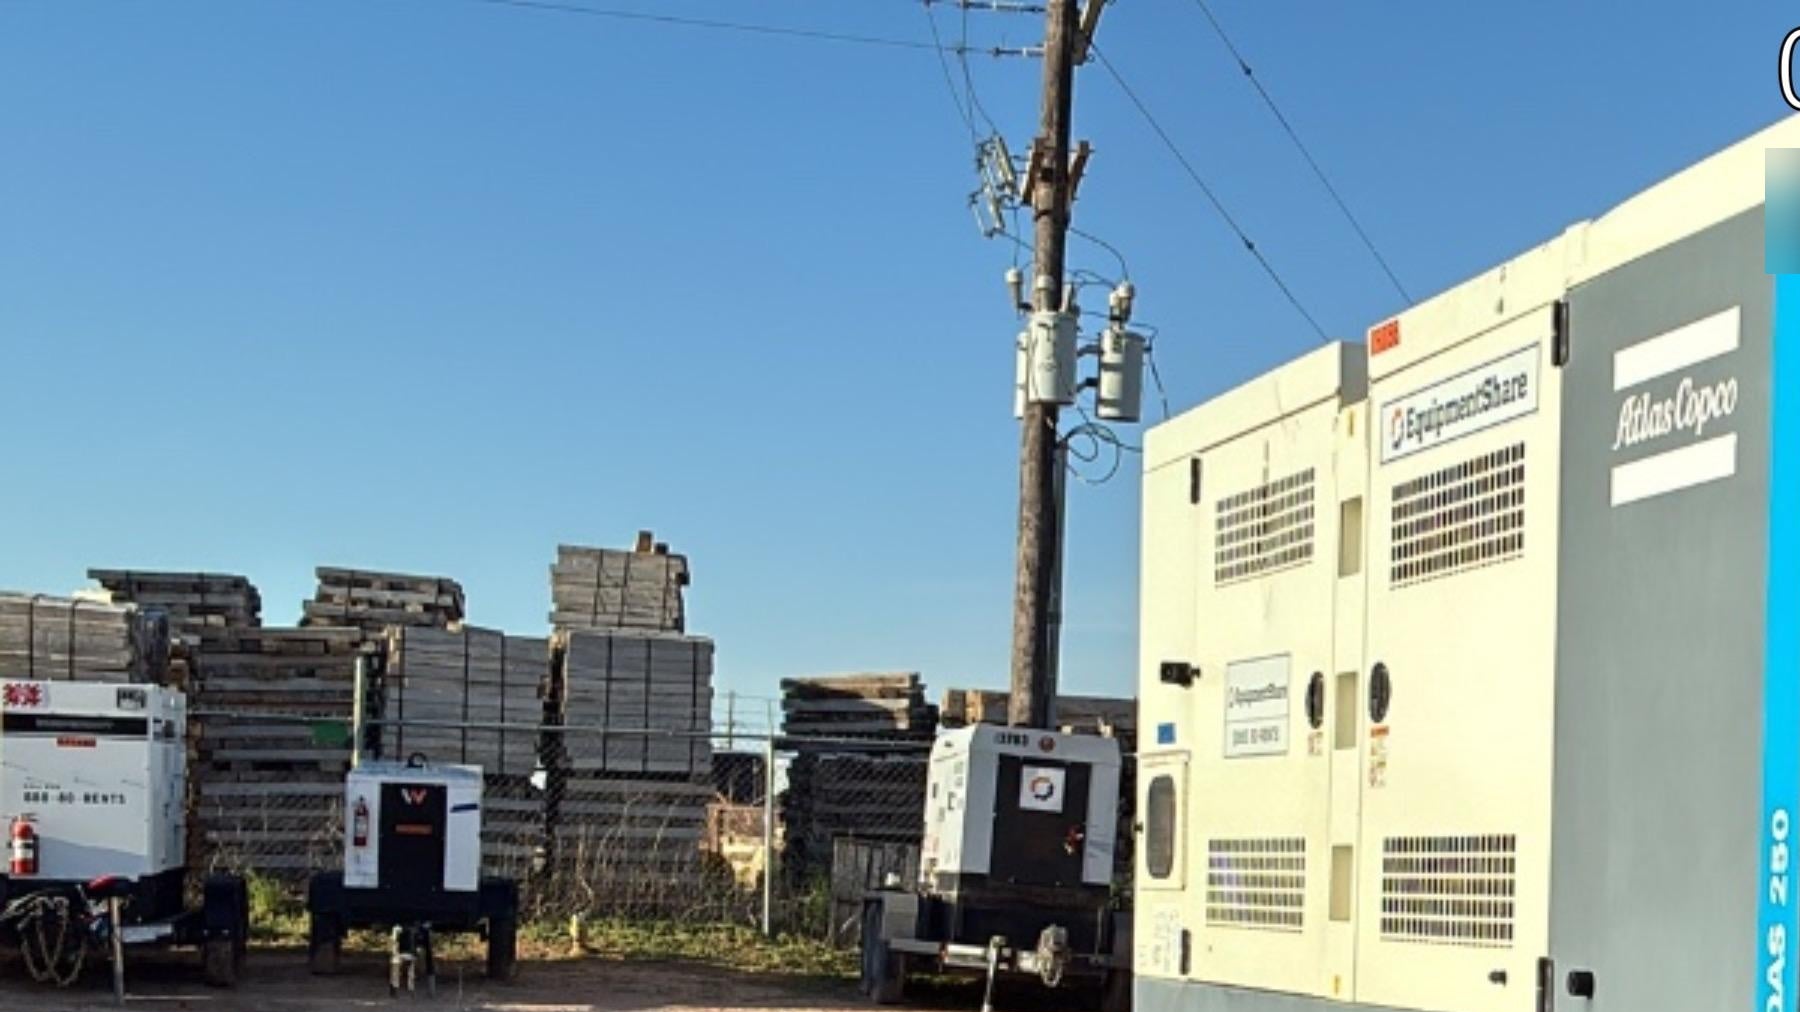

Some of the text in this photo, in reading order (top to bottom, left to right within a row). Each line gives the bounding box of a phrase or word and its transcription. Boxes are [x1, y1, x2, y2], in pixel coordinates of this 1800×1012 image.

[1405, 371, 1528, 444] EquipmentShare
[1611, 376, 1738, 450] Atlas Copco
